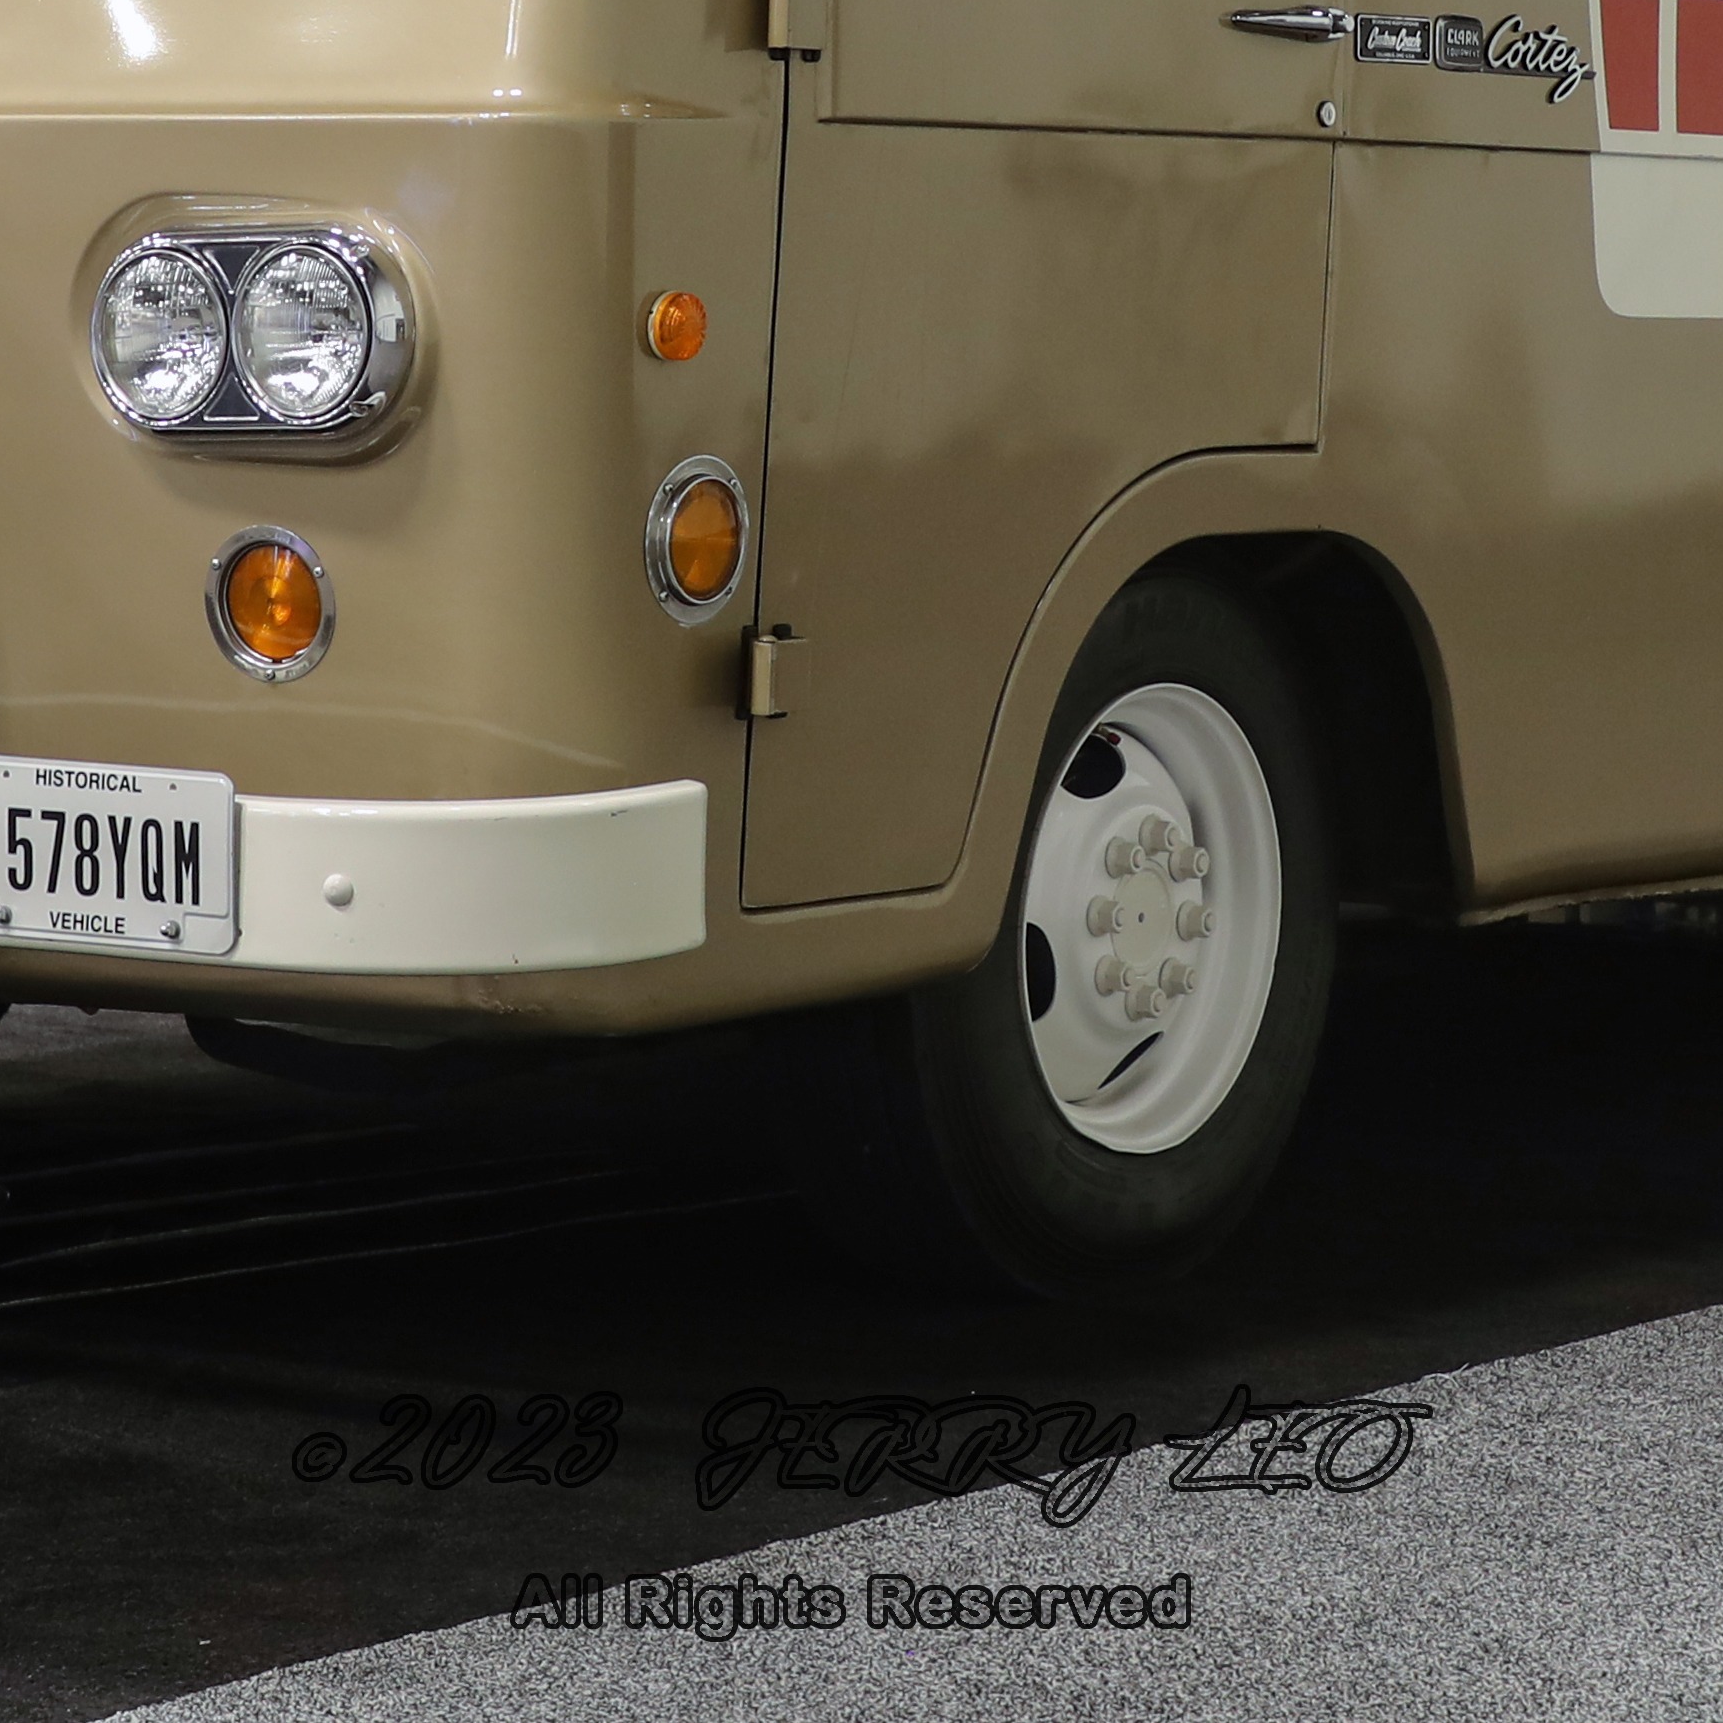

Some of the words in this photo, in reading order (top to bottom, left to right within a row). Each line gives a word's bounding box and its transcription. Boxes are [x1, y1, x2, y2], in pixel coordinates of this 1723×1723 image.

[1447, 28, 1480, 46] CLARK
[1486, 15, 1590, 104] Cortez
[35, 768, 142, 794] HISTORICAL
[7, 806, 200, 907] 578YQM
[49, 911, 126, 935] VEHICLE
